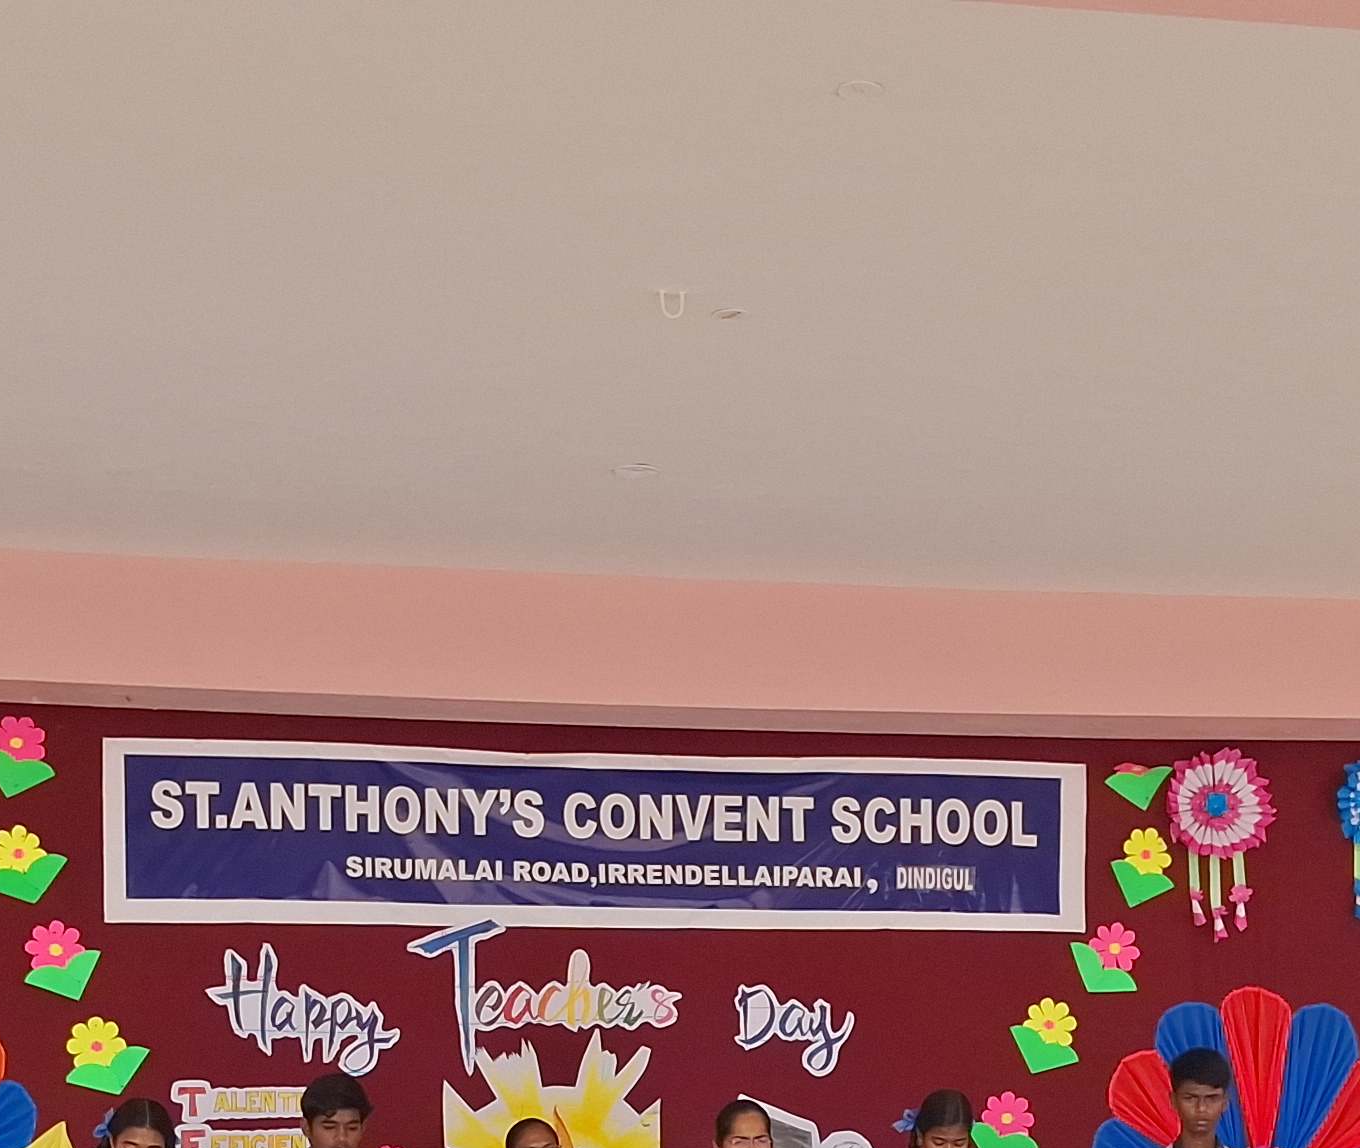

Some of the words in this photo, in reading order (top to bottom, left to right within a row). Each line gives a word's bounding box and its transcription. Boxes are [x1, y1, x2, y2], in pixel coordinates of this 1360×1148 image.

[149, 780, 545, 838] ST.ANTHONY'S
[563, 792, 815, 843] CONVENT
[831, 797, 1039, 847] SCHOOL
[345, 856, 504, 882] SIRUMALAI
[896, 866, 975, 891] DINDIGUL
[215, 949, 397, 1072] Happy
[738, 987, 853, 1072] Day
